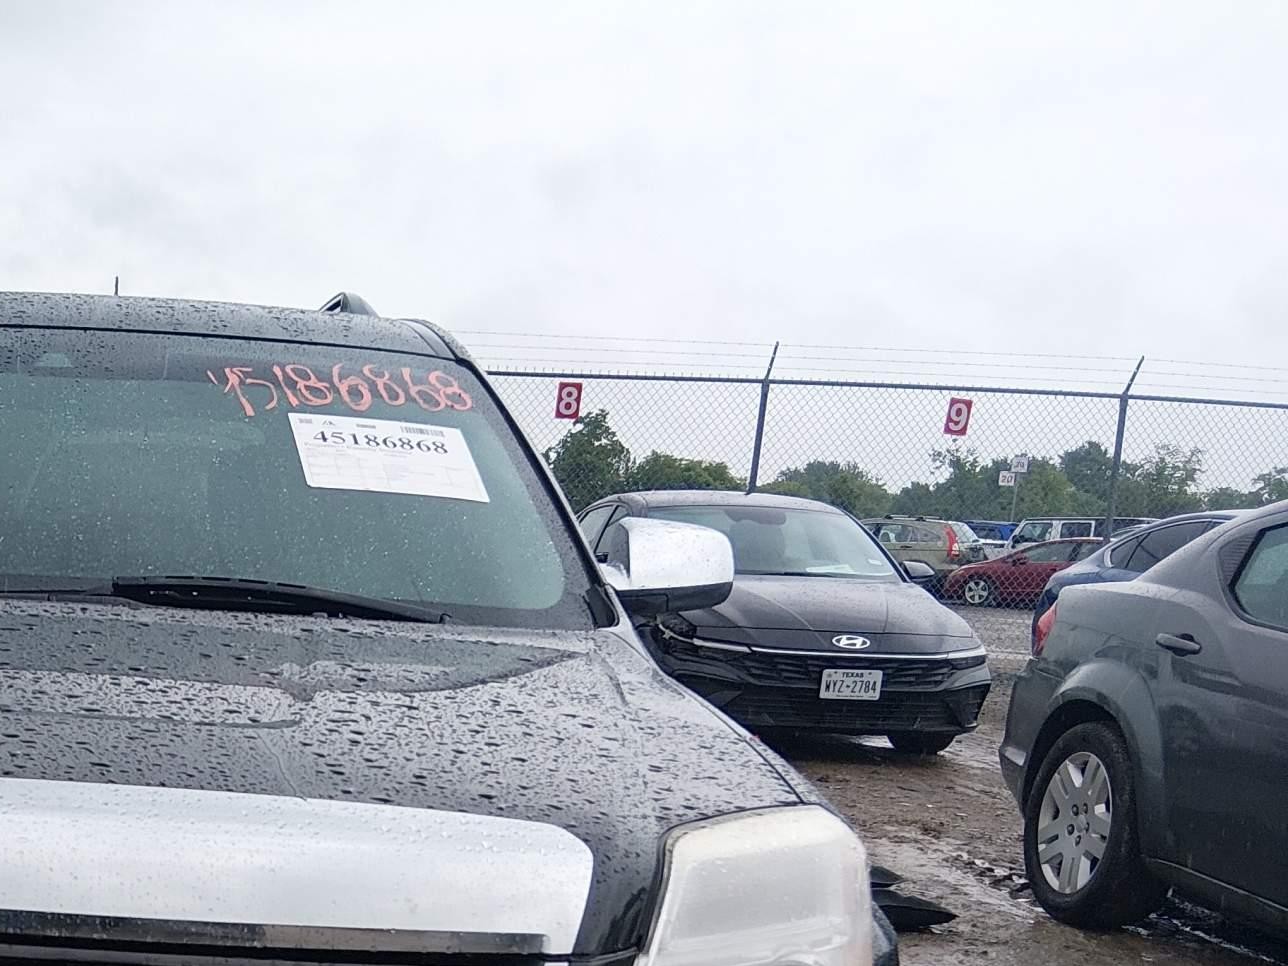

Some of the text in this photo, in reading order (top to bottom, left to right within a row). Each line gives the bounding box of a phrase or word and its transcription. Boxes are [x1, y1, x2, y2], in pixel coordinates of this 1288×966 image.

[559, 386, 578, 415] 8
[948, 403, 968, 431] 9
[313, 430, 449, 455] 45186868
